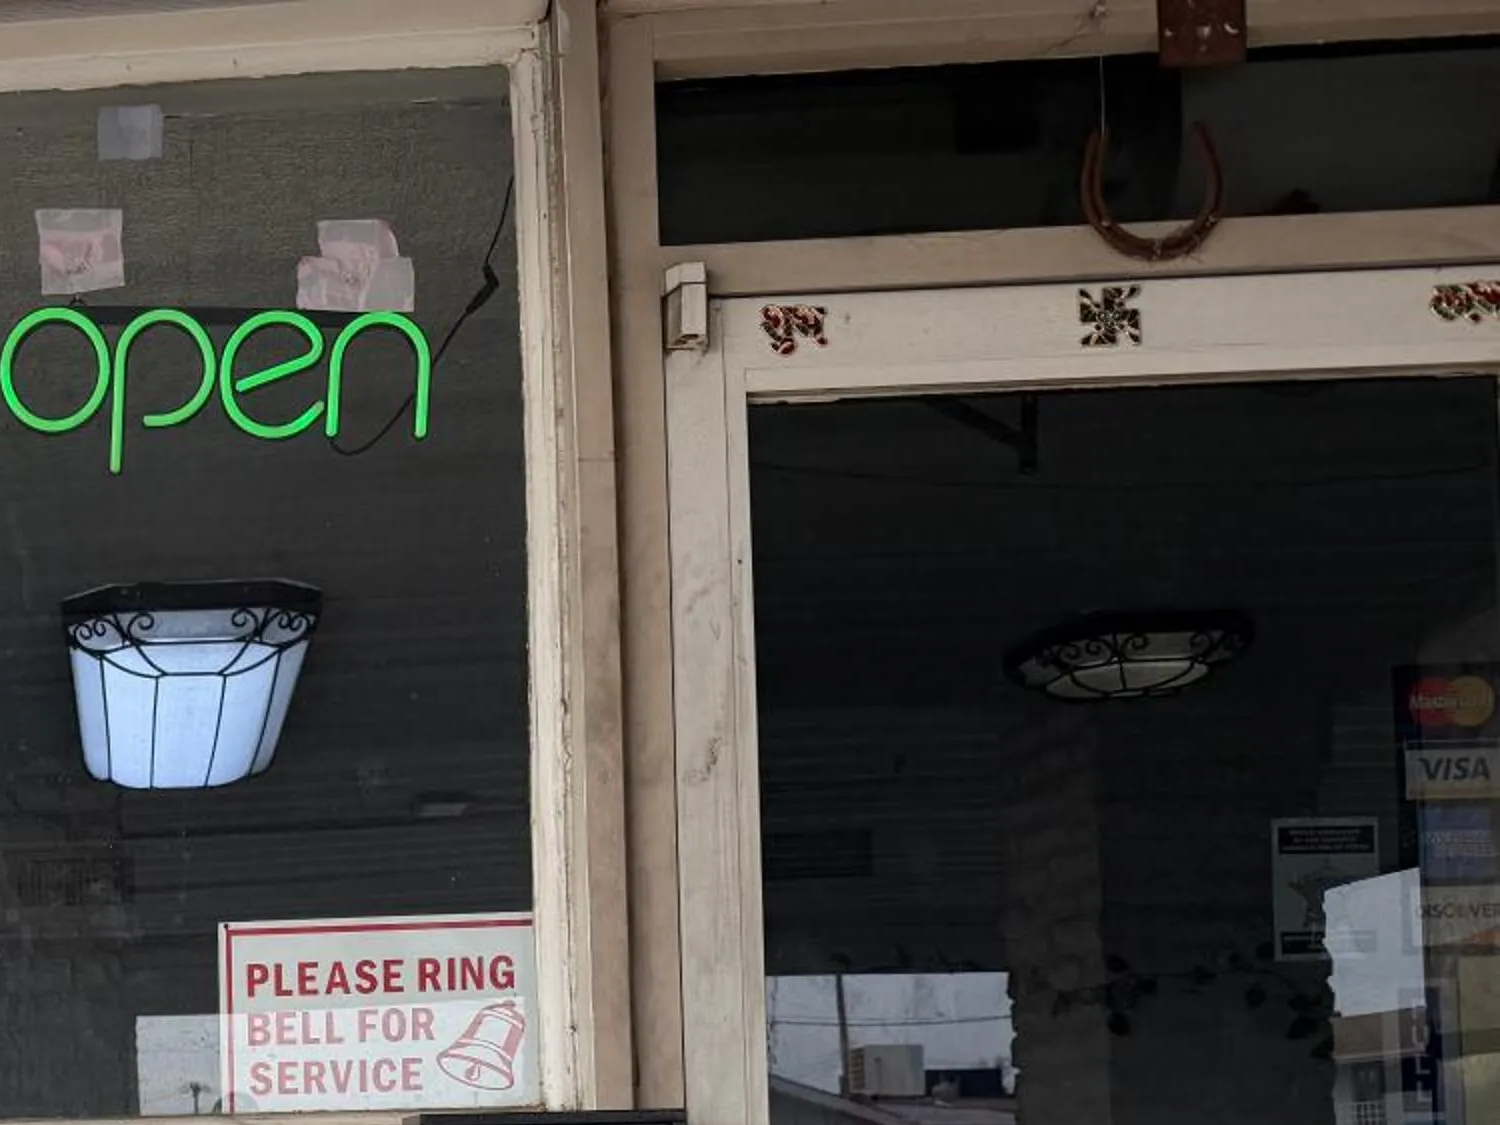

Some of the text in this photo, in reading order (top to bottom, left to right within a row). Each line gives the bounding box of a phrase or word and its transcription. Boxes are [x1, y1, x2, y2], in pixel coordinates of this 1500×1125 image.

[0, 305, 432, 475] open
[1417, 756, 1491, 782] VISA
[246, 955, 515, 998] PLEASE RING
[247, 1007, 435, 1047] BELL FOR
[250, 1058, 423, 1096] SERVICE
